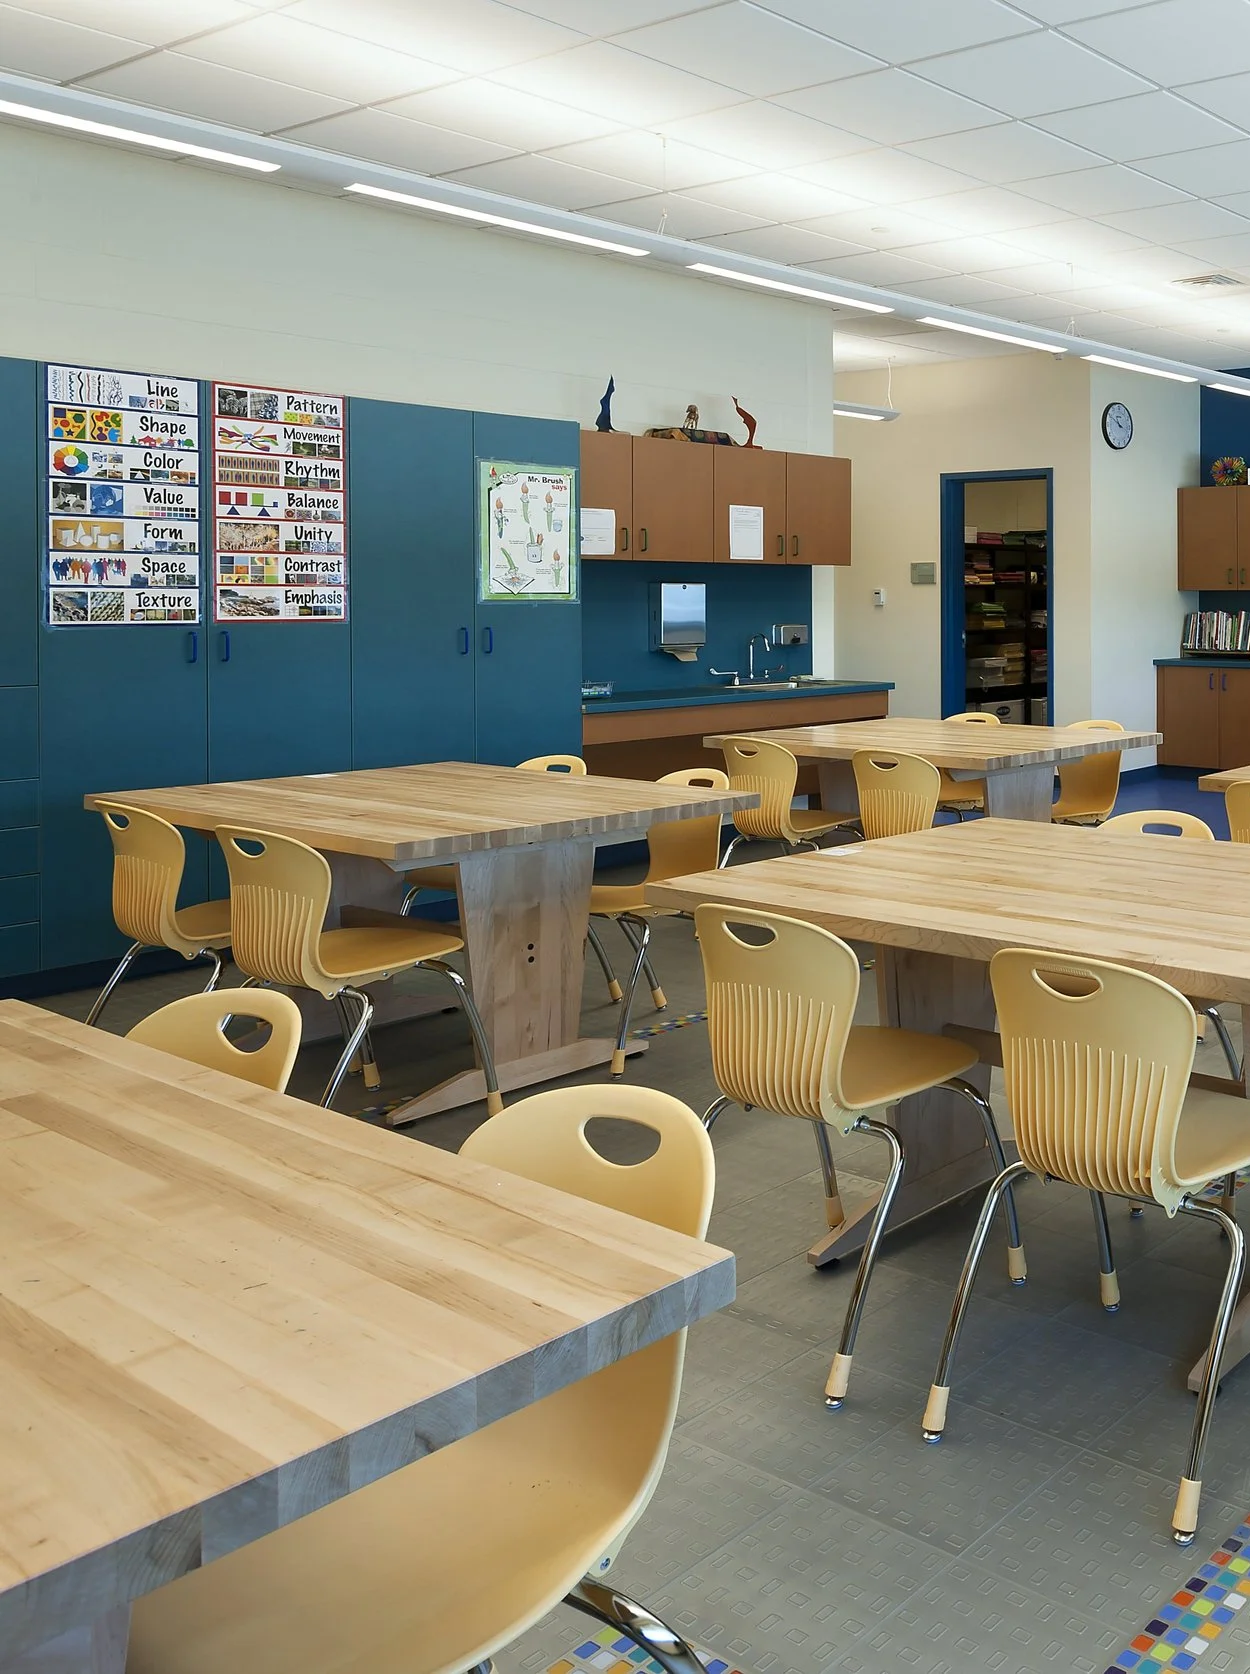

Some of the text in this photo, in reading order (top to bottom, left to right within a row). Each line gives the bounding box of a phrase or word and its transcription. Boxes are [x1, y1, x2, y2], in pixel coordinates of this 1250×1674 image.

[147, 379, 178, 398] Line
[286, 395, 338, 415] Pattern
[139, 415, 187, 437] Shape
[283, 427, 341, 444] Movement
[143, 451, 184, 470] Color
[284, 460, 340, 480] Rhythm
[527, 475, 540, 483] Mr.
[542, 476, 564, 485] Brush
[143, 487, 184, 505] Value
[287, 492, 339, 509] Balance
[143, 523, 183, 540] Form
[294, 525, 333, 543] Unity
[141, 557, 186, 576] Space
[284, 557, 342, 573] Contrast
[135, 591, 192, 608] Texture
[284, 589, 342, 607] Emphasis
